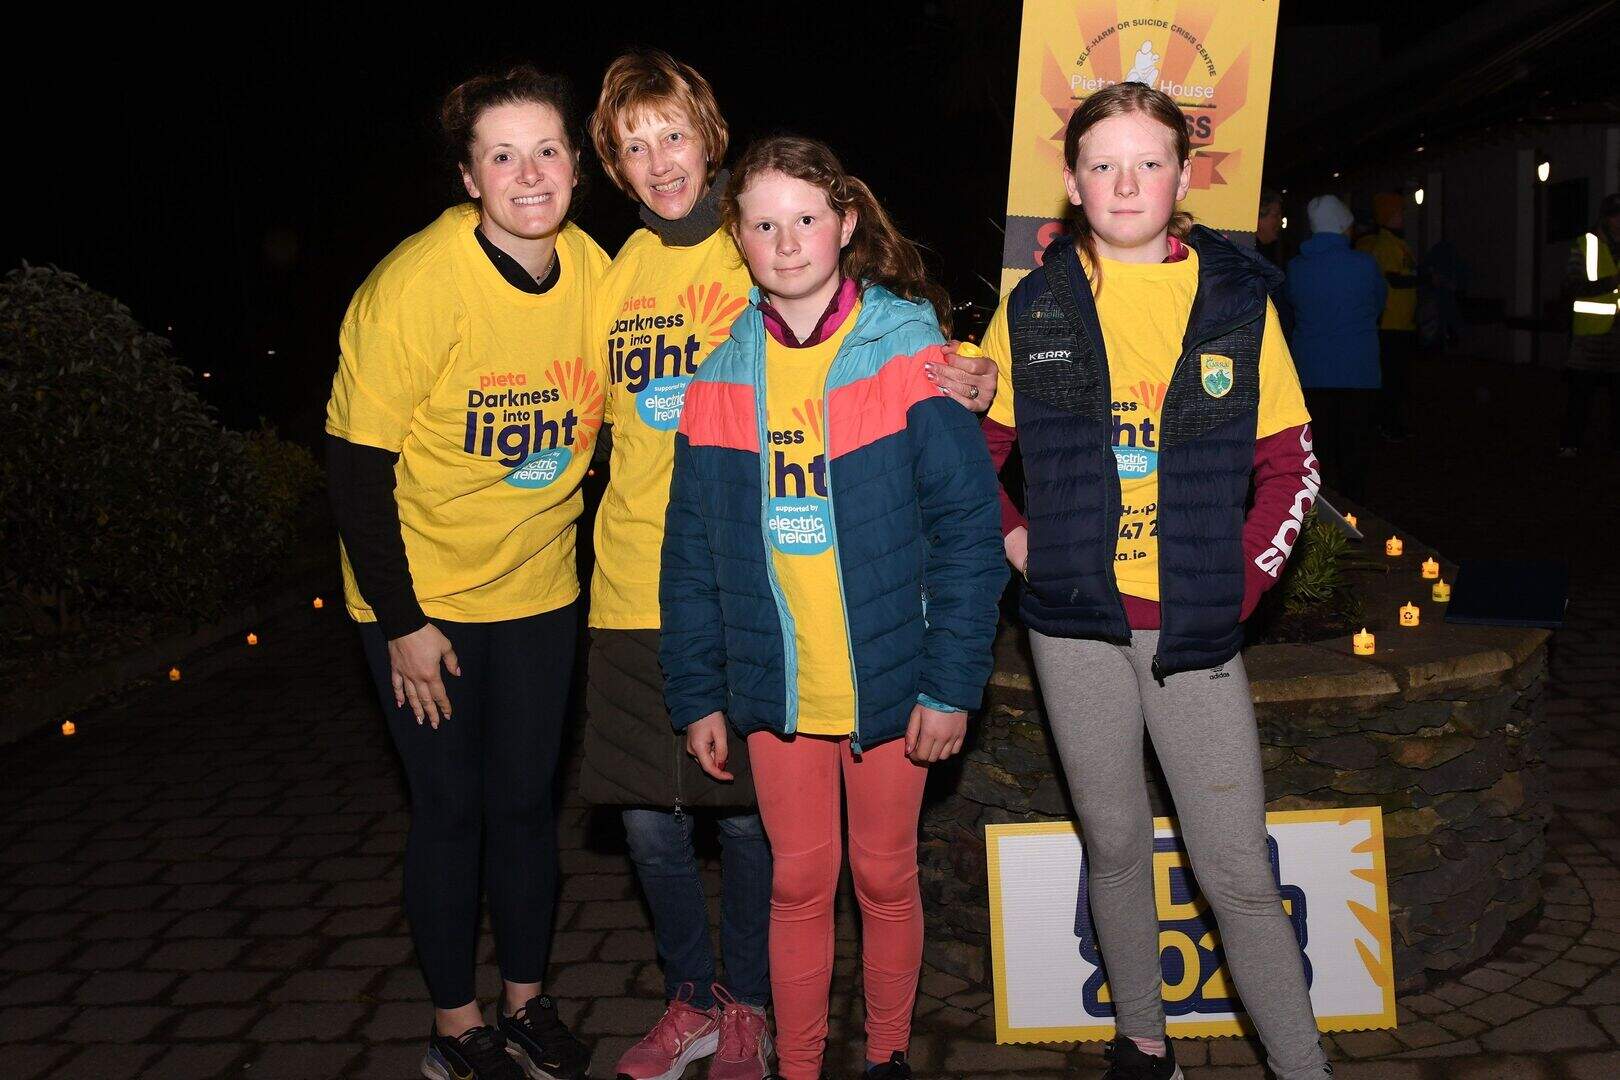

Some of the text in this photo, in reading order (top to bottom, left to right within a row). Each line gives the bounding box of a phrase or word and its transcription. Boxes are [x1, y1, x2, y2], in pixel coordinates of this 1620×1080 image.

[1077, 19, 1217, 78] SELF-HARM OR SUICIDE CRISIS CENTRE
[1160, 79, 1215, 99] House
[630, 333, 652, 346] into
[607, 333, 701, 394] light
[1029, 350, 1072, 361] KERRY
[479, 371, 527, 391] pieta
[467, 388, 560, 408] Darkness
[1111, 400, 1138, 412] ess
[503, 410, 531, 423] into
[464, 408, 578, 468] light
[776, 503, 819, 513] supported by
[769, 514, 824, 531] electric
[778, 530, 827, 545] Ireland
